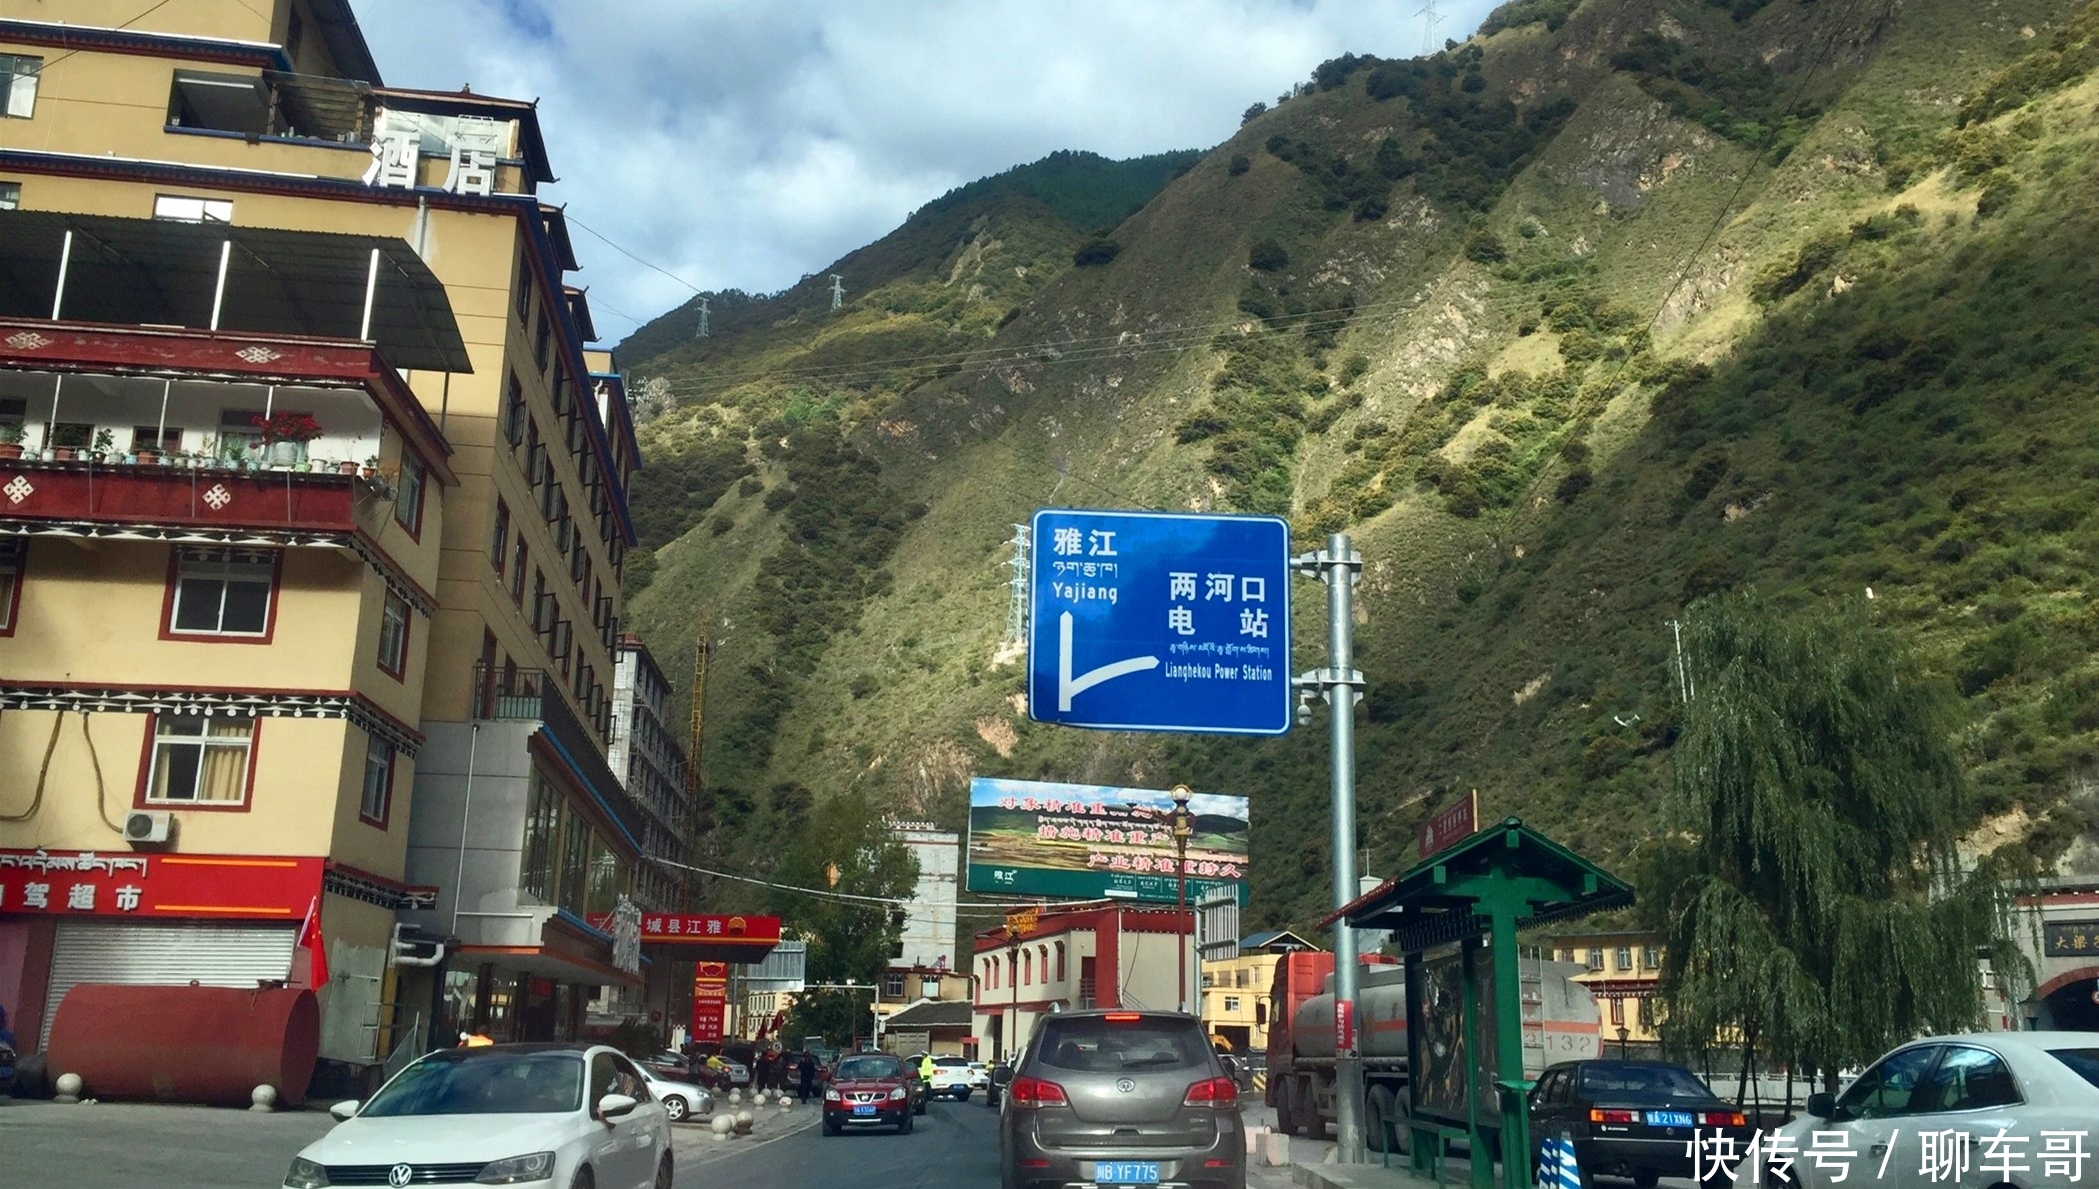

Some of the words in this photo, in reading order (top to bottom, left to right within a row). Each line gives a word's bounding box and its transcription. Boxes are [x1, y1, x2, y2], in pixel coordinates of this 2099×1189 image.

[362, 127, 496, 197] 酒店
[1053, 527, 1118, 557] 雅江
[1052, 582, 1118, 605] Yajiang
[1169, 571, 1266, 602] 两河口
[1168, 605, 1269, 638] 电站
[1165, 661, 1212, 683] Lianghekou
[1214, 663, 1239, 680] Power
[1242, 664, 1272, 681] Station
[0, 882, 142, 911] 驾超市
